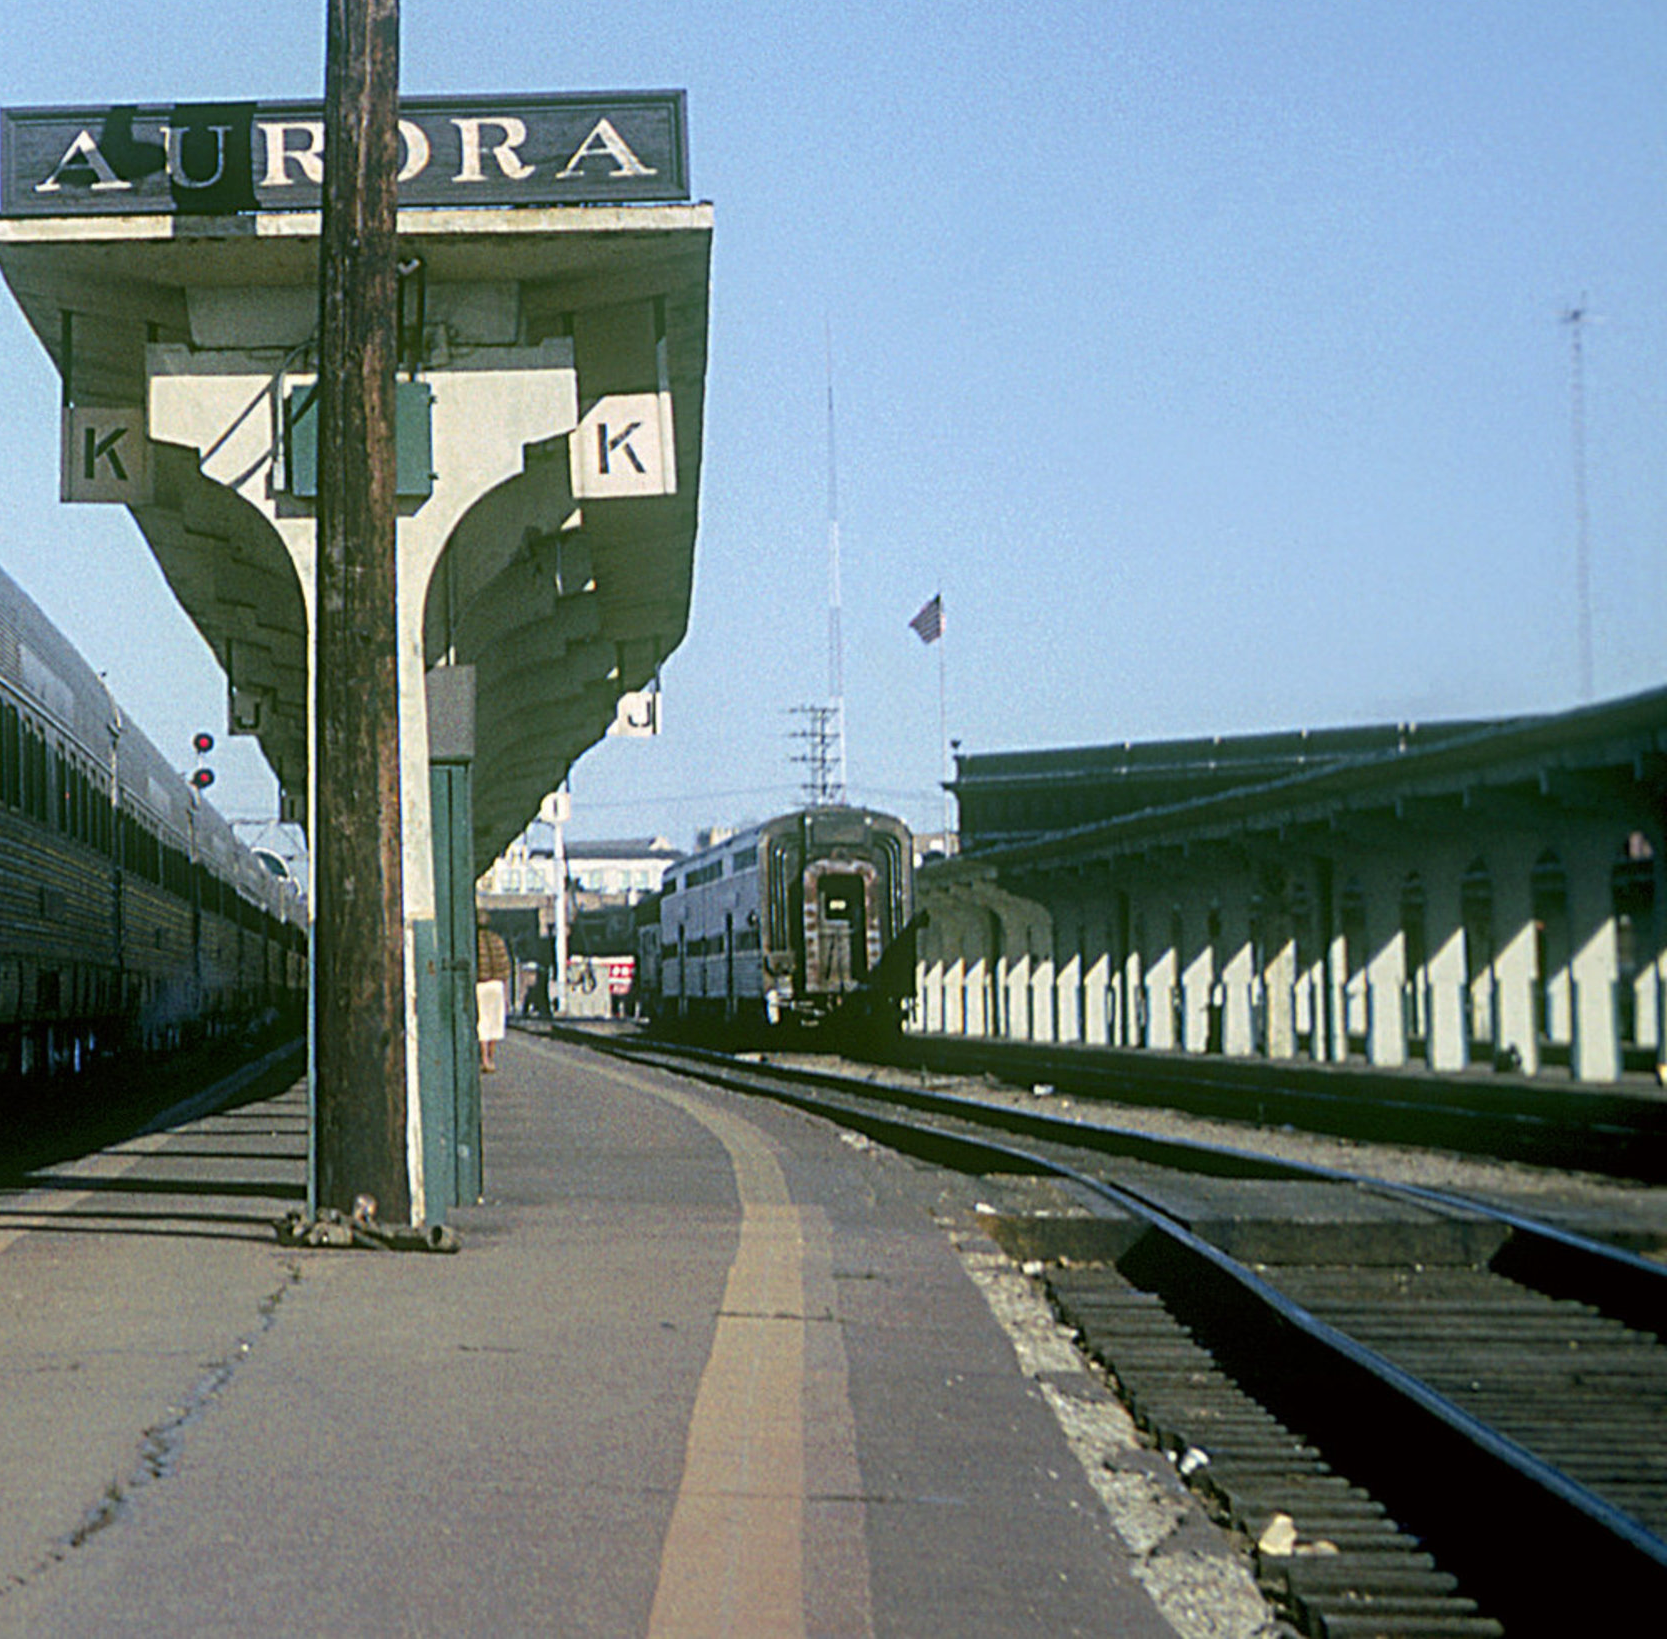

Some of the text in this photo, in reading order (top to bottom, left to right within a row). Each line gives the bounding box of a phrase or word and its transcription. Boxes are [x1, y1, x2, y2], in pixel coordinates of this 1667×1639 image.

[84, 426, 129, 482] K
[597, 421, 646, 475] K
[235, 701, 261, 730] J
[627, 700, 652, 728] J
